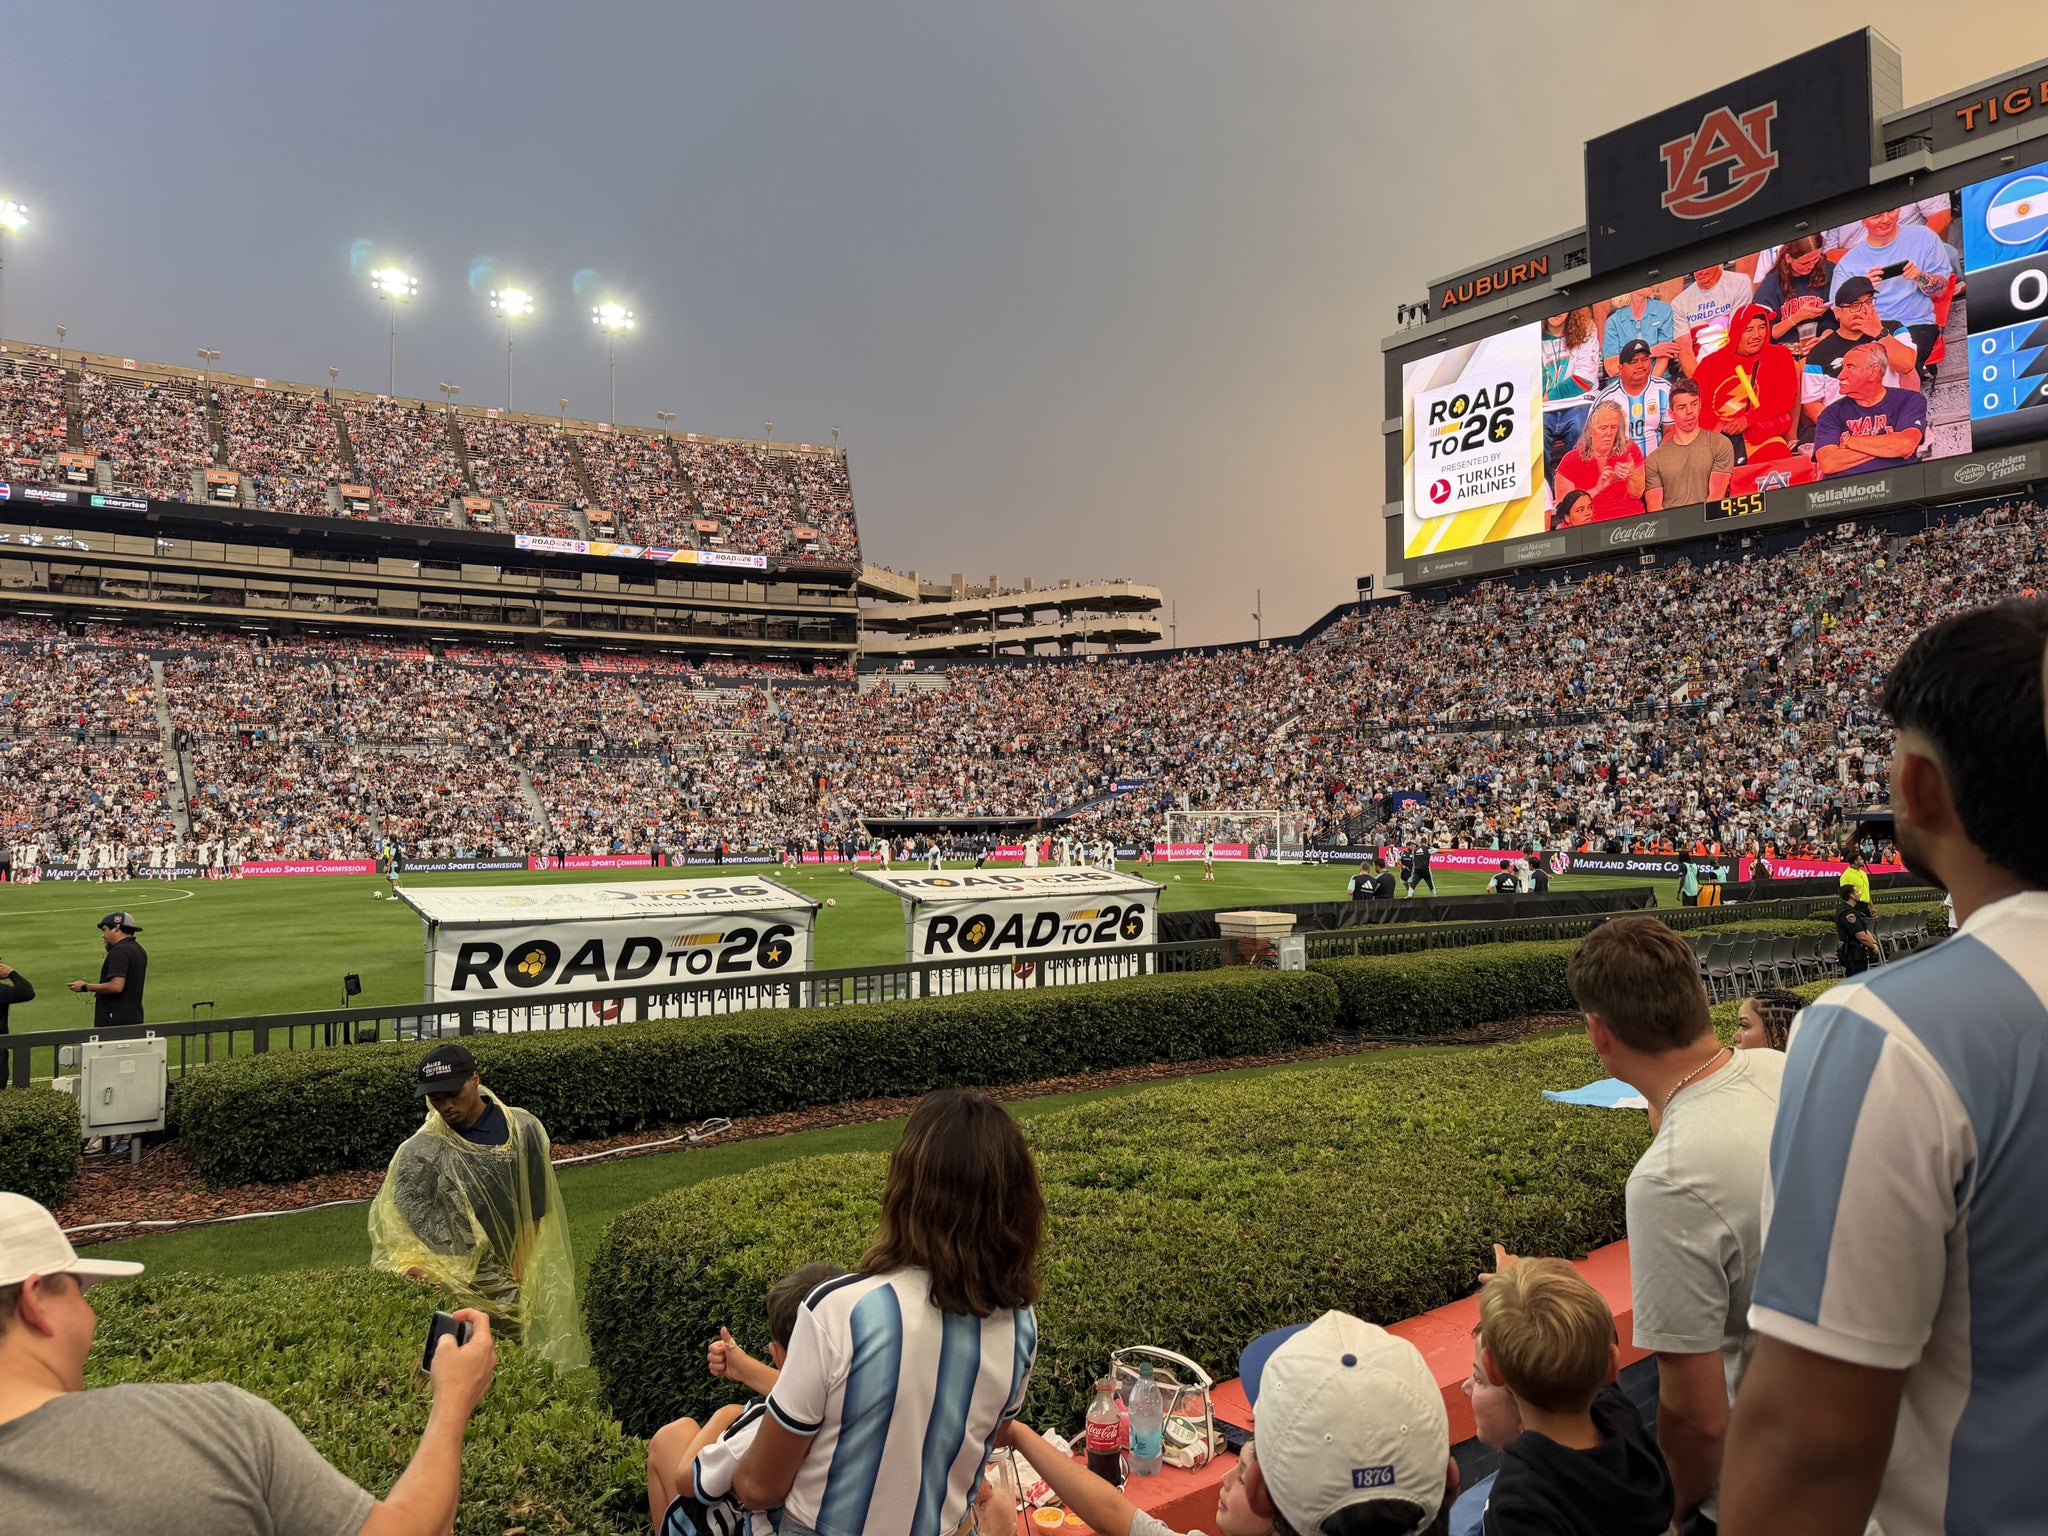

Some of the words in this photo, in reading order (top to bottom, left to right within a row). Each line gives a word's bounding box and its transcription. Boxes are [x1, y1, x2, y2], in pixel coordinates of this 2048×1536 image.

[1441, 255, 1548, 309] AUBURN
[2010, 269, 2048, 311] 0
[1698, 301, 1716, 311] FIFA
[1714, 303, 1731, 315] CUP
[1981, 338, 1996, 354] 0
[1982, 365, 1998, 381] 0
[1428, 380, 1515, 427] ROAD
[1983, 393, 1999, 409] 0
[1846, 414, 1887, 434] WAR
[1429, 436, 1459, 459] TO
[1441, 455, 1489, 473] PRESENTED
[1490, 452, 1502, 461] BY
[1987, 454, 2026, 472] Golden
[1991, 462, 2025, 480] Flake
[1457, 462, 1515, 486] TURKISH
[1457, 475, 1516, 500] AIRLINES
[94, 497, 146, 510] enterprise
[1720, 493, 1764, 517] 9:55
[1811, 498, 1841, 510] Pressure
[1842, 495, 1869, 504] Treated
[1870, 492, 1886, 501] Pine
[531, 537, 555, 546] ROAD
[715, 553, 737, 562] ROAD
[1330, 850, 1374, 860] COMMISSION
[1446, 854, 1476, 864] SPORTS
[283, 865, 315, 873] SPORTS
[316, 864, 367, 873] COMMISSION
[404, 862, 446, 871] MARYLAND
[447, 862, 475, 870] SPORTS
[476, 861, 523, 869] COMMISSION
[1573, 859, 1625, 869] MARYLAND
[1626, 860, 1662, 871] SPORTS
[888, 874, 1025, 888] ROAD
[641, 893, 692, 901] TO
[692, 884, 769, 900] 26
[711, 896, 785, 906] AIRLINES
[923, 911, 1062, 955] ROAD
[1062, 923, 1092, 945] TO
[1093, 903, 1146, 943] 26
[450, 936, 663, 992] ROAD
[665, 948, 714, 977] TO
[715, 924, 795, 974] 26
[647, 990, 711, 1007] URKISH
[1355, 1466, 1392, 1486] 1876
